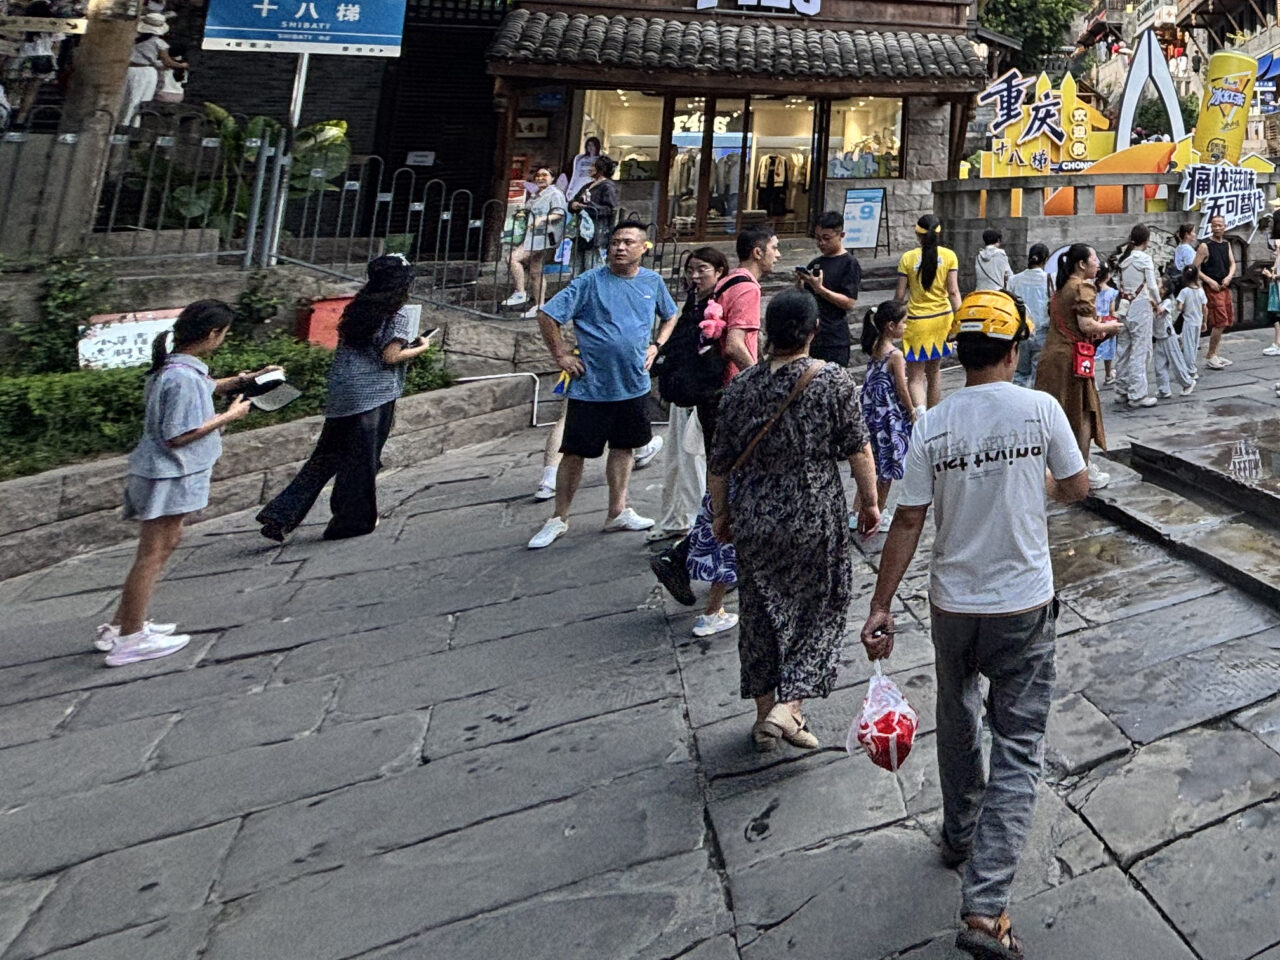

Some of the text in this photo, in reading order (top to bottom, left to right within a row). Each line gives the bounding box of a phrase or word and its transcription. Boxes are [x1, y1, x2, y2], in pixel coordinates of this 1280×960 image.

[281, 21, 330, 29] SHIBATI
[978, 68, 1067, 145] 重庆
[1071, 108, 1087, 158] 欢迎你
[994, 140, 1050, 172] 十八梯
[1186, 166, 1256, 206] 痛快滋味
[1206, 190, 1264, 225] 无可替代
